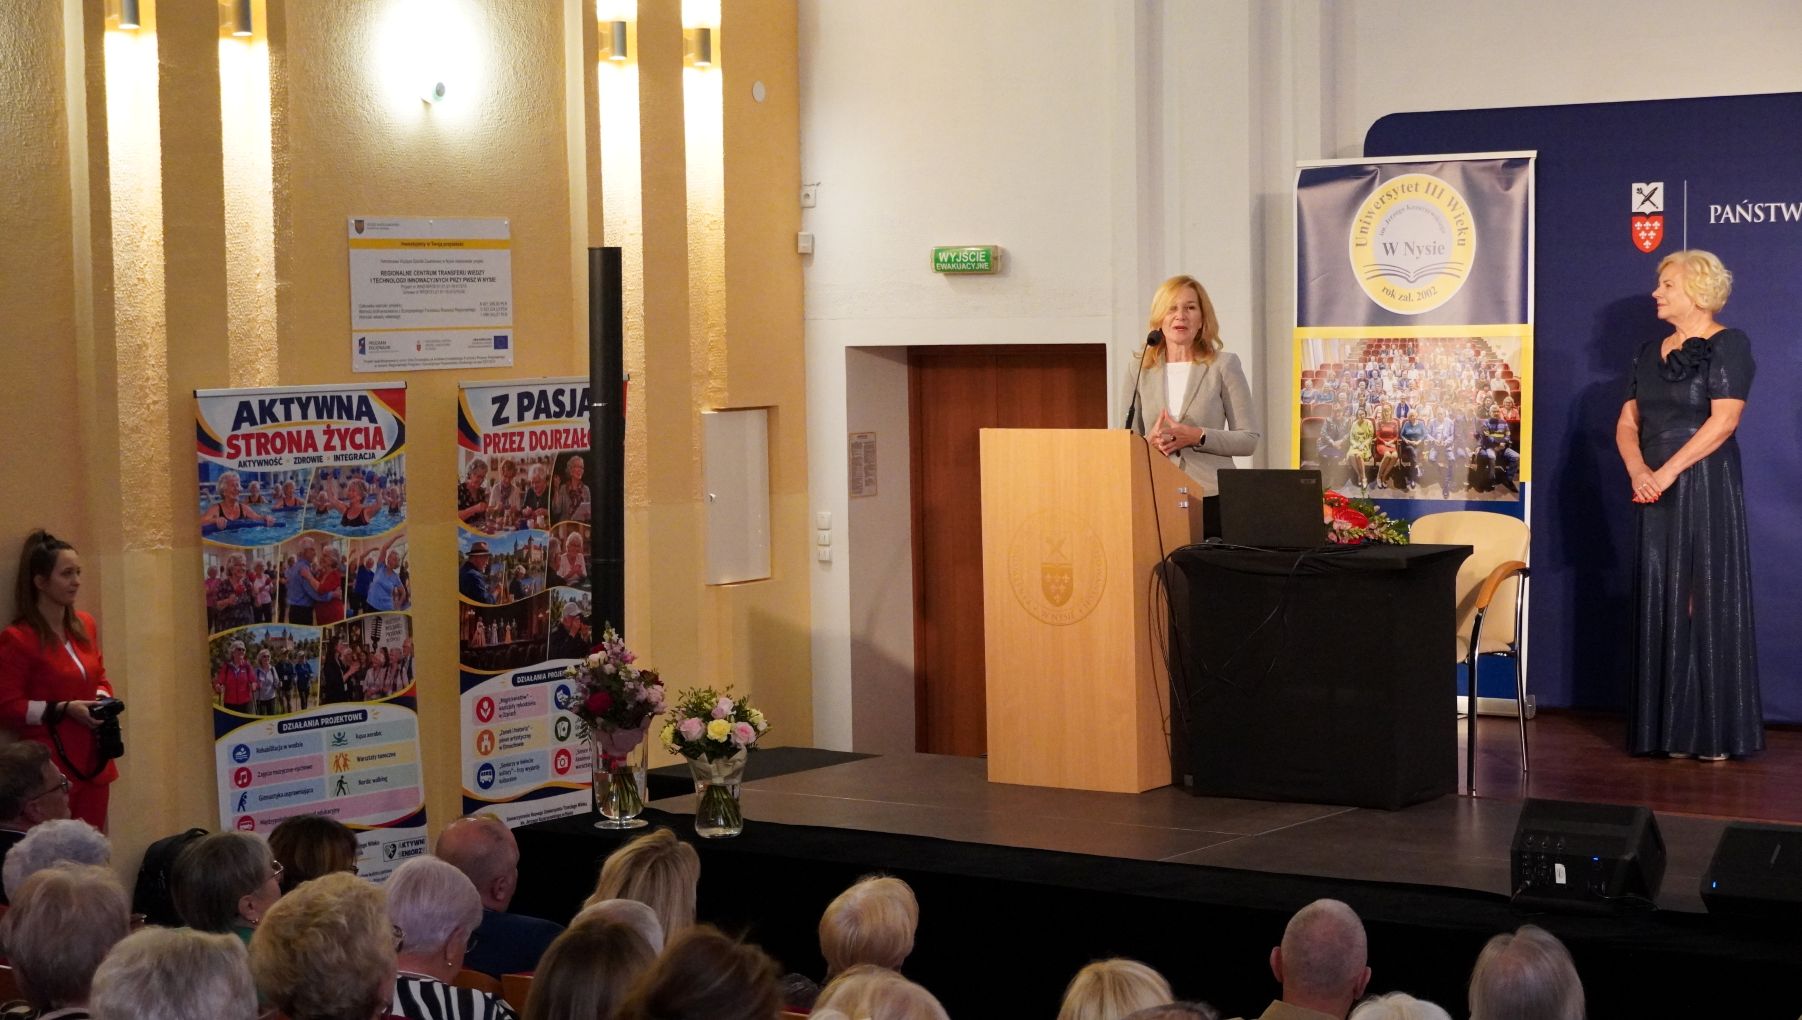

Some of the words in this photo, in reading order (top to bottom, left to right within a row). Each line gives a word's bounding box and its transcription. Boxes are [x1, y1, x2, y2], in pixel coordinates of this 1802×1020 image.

[1356, 182, 1420, 248] Uniwersytet
[1424, 182, 1444, 200] III
[1447, 197, 1469, 247] Wieku
[1382, 242, 1398, 256] W
[1404, 240, 1446, 260] Nysie
[1382, 286, 1396, 298] rok
[1417, 286, 1438, 301] 2002
[231, 395, 378, 432] AKTYWNA
[491, 394, 510, 427] Z
[226, 429, 319, 460] STRONA
[323, 424, 386, 452] ŻYCIA
[483, 432, 525, 454] PRZEZ
[529, 427, 590, 452] DOJRZAŁ
[238, 456, 283, 469] AKTYWNOŚĆ
[293, 456, 324, 465] ZDROWIE
[334, 452, 376, 462] INTEGRACJA
[517, 674, 546, 684] DZIAŁANIA
[548, 670, 566, 680] PROJE
[282, 718, 320, 731] DZIAŁANIA
[321, 712, 362, 727] PROJEKTOWE
